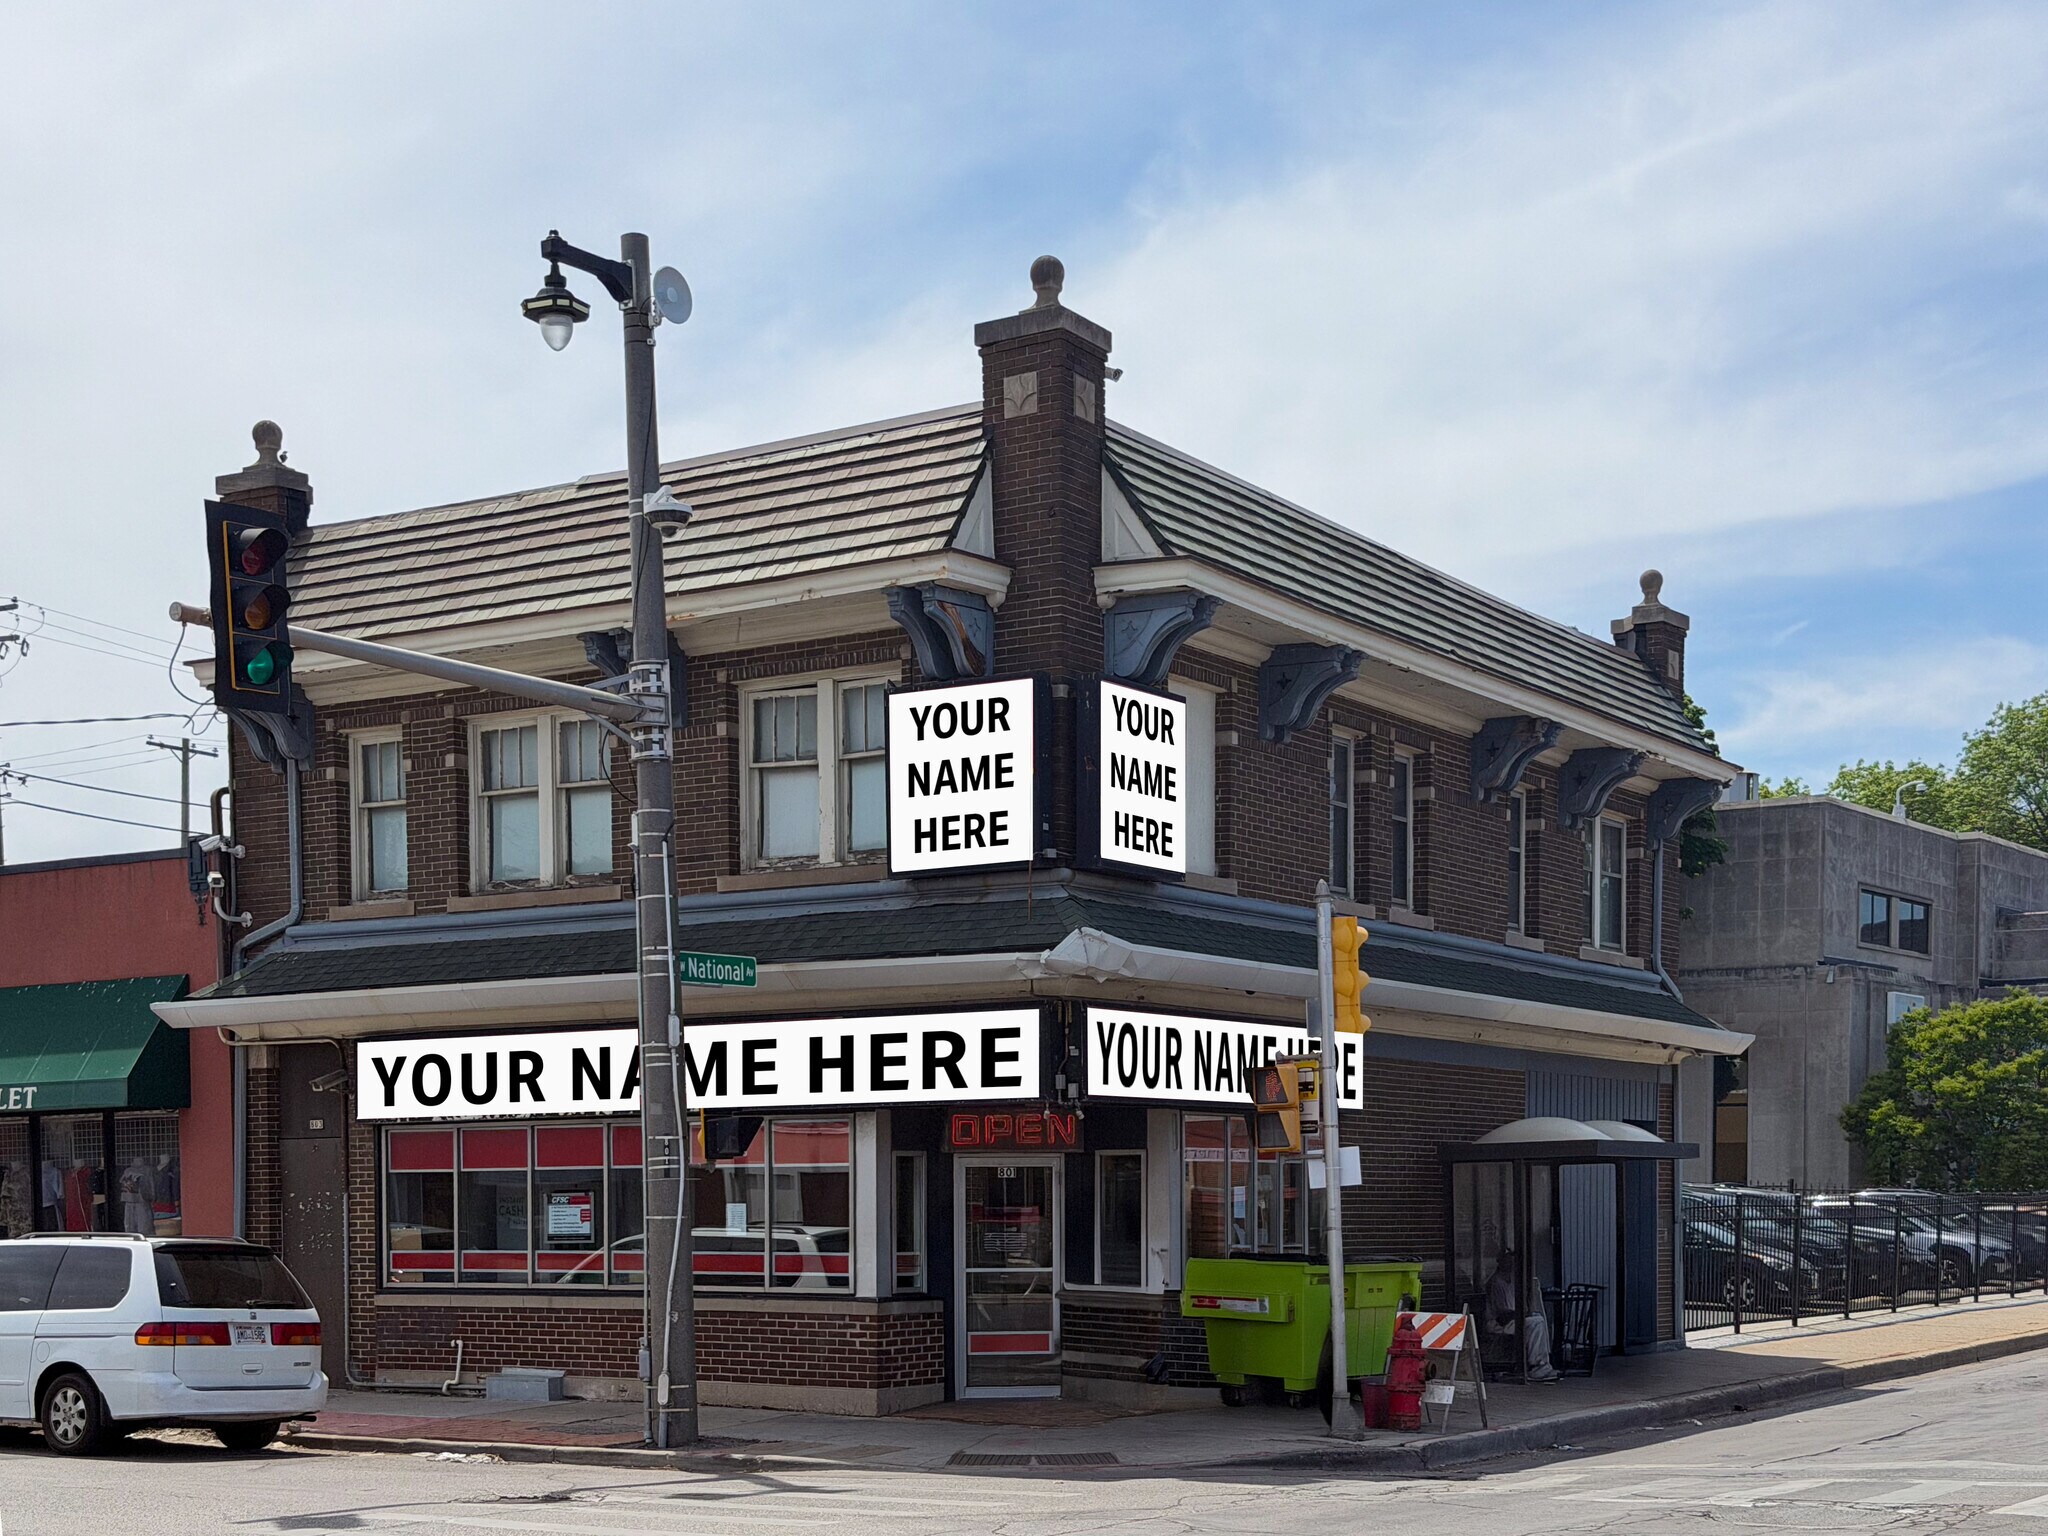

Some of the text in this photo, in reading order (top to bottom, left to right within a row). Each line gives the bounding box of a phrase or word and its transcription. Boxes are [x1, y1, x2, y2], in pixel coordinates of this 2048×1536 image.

[909, 697, 1010, 741] YOUR
[1112, 695, 1174, 745] YOUR
[908, 753, 1014, 798] NAME
[1111, 752, 1177, 802] NAME
[914, 811, 1009, 853] HERE
[1114, 811, 1173, 857] HERE
[688, 957, 744, 981] National
[372, 1051, 546, 1106] YOUR
[810, 1027, 1022, 1093] HERE
[1097, 1022, 1182, 1089] YOUR
[952, 1114, 1076, 1145] OPEN
[999, 1167, 1015, 1177] 801
[499, 1205, 524, 1216] CASH
